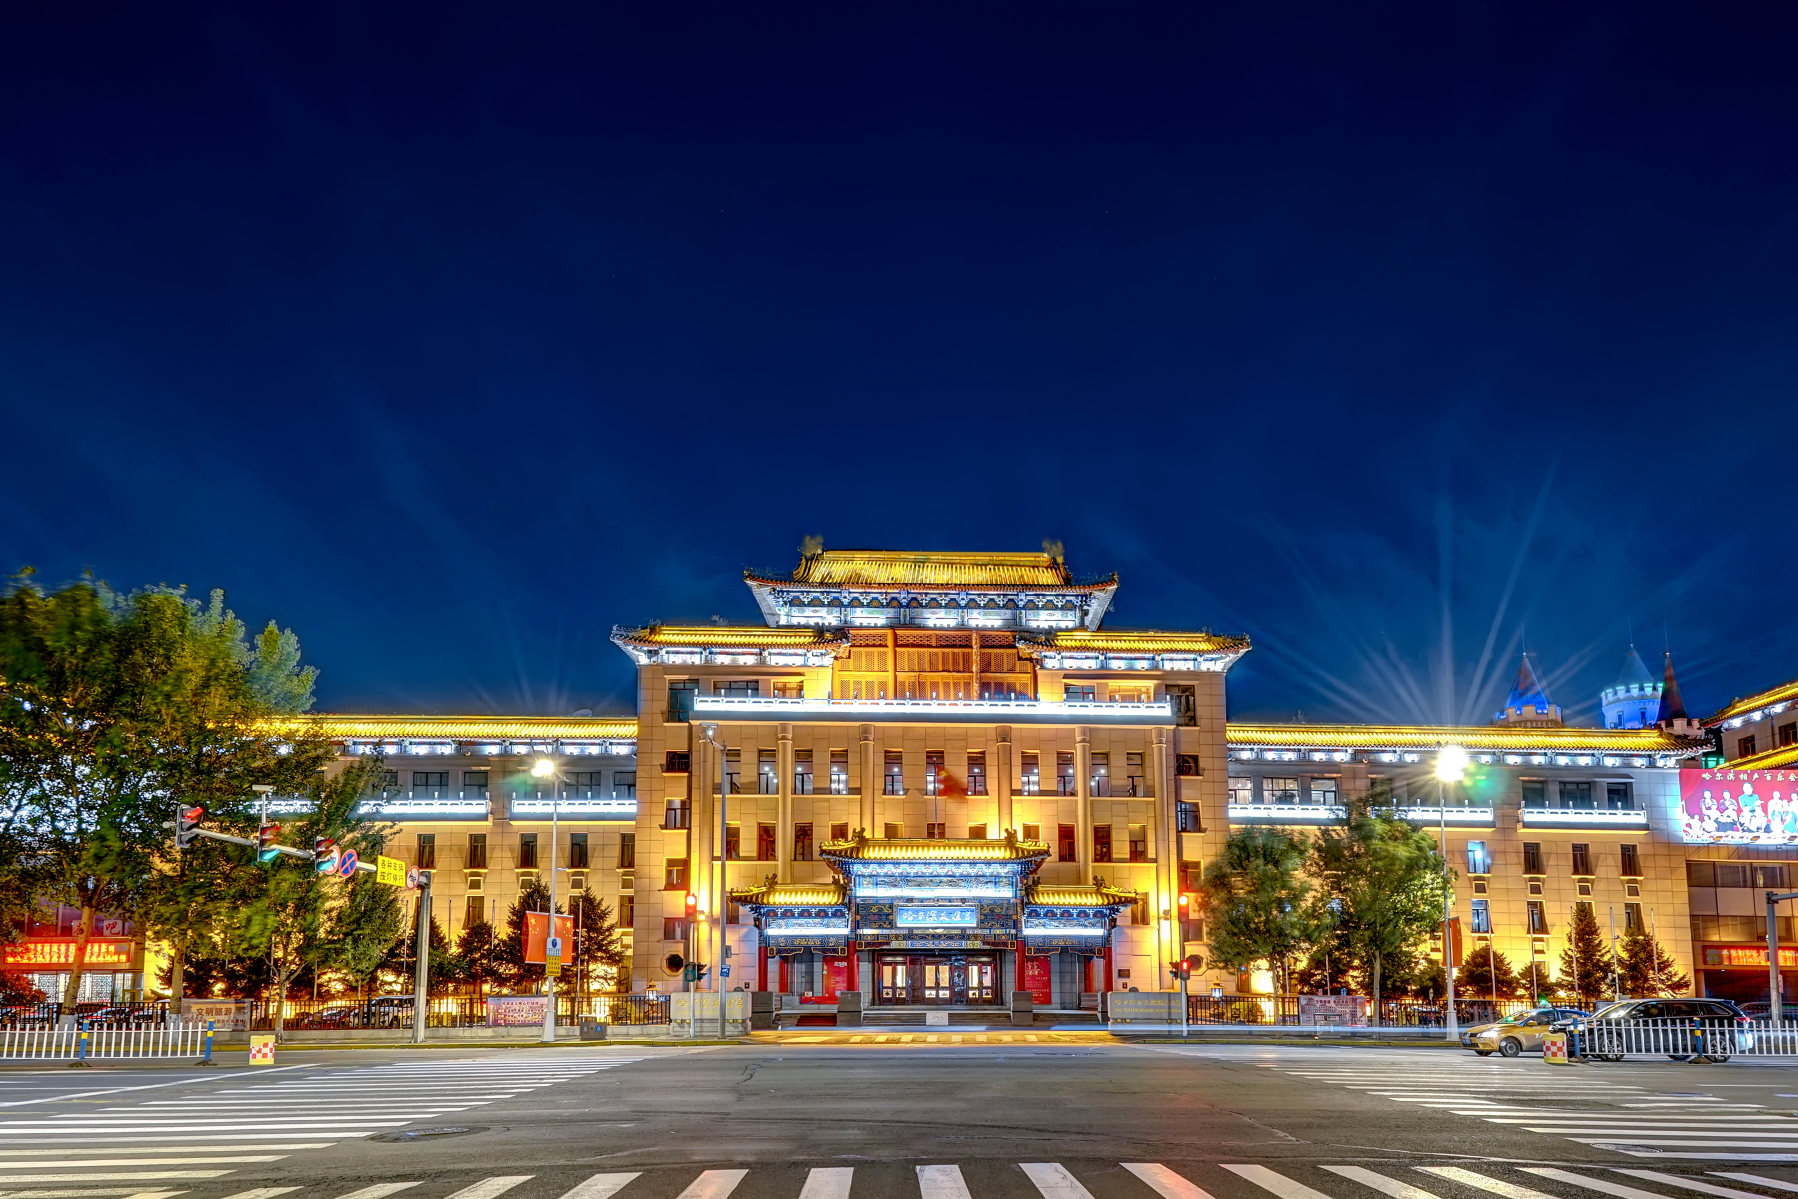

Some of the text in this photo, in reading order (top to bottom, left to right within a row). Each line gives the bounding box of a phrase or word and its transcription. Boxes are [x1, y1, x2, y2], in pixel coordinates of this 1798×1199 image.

[380, 859, 404, 874] 各种车辆
[195, 1007, 233, 1017] 文明旅游
